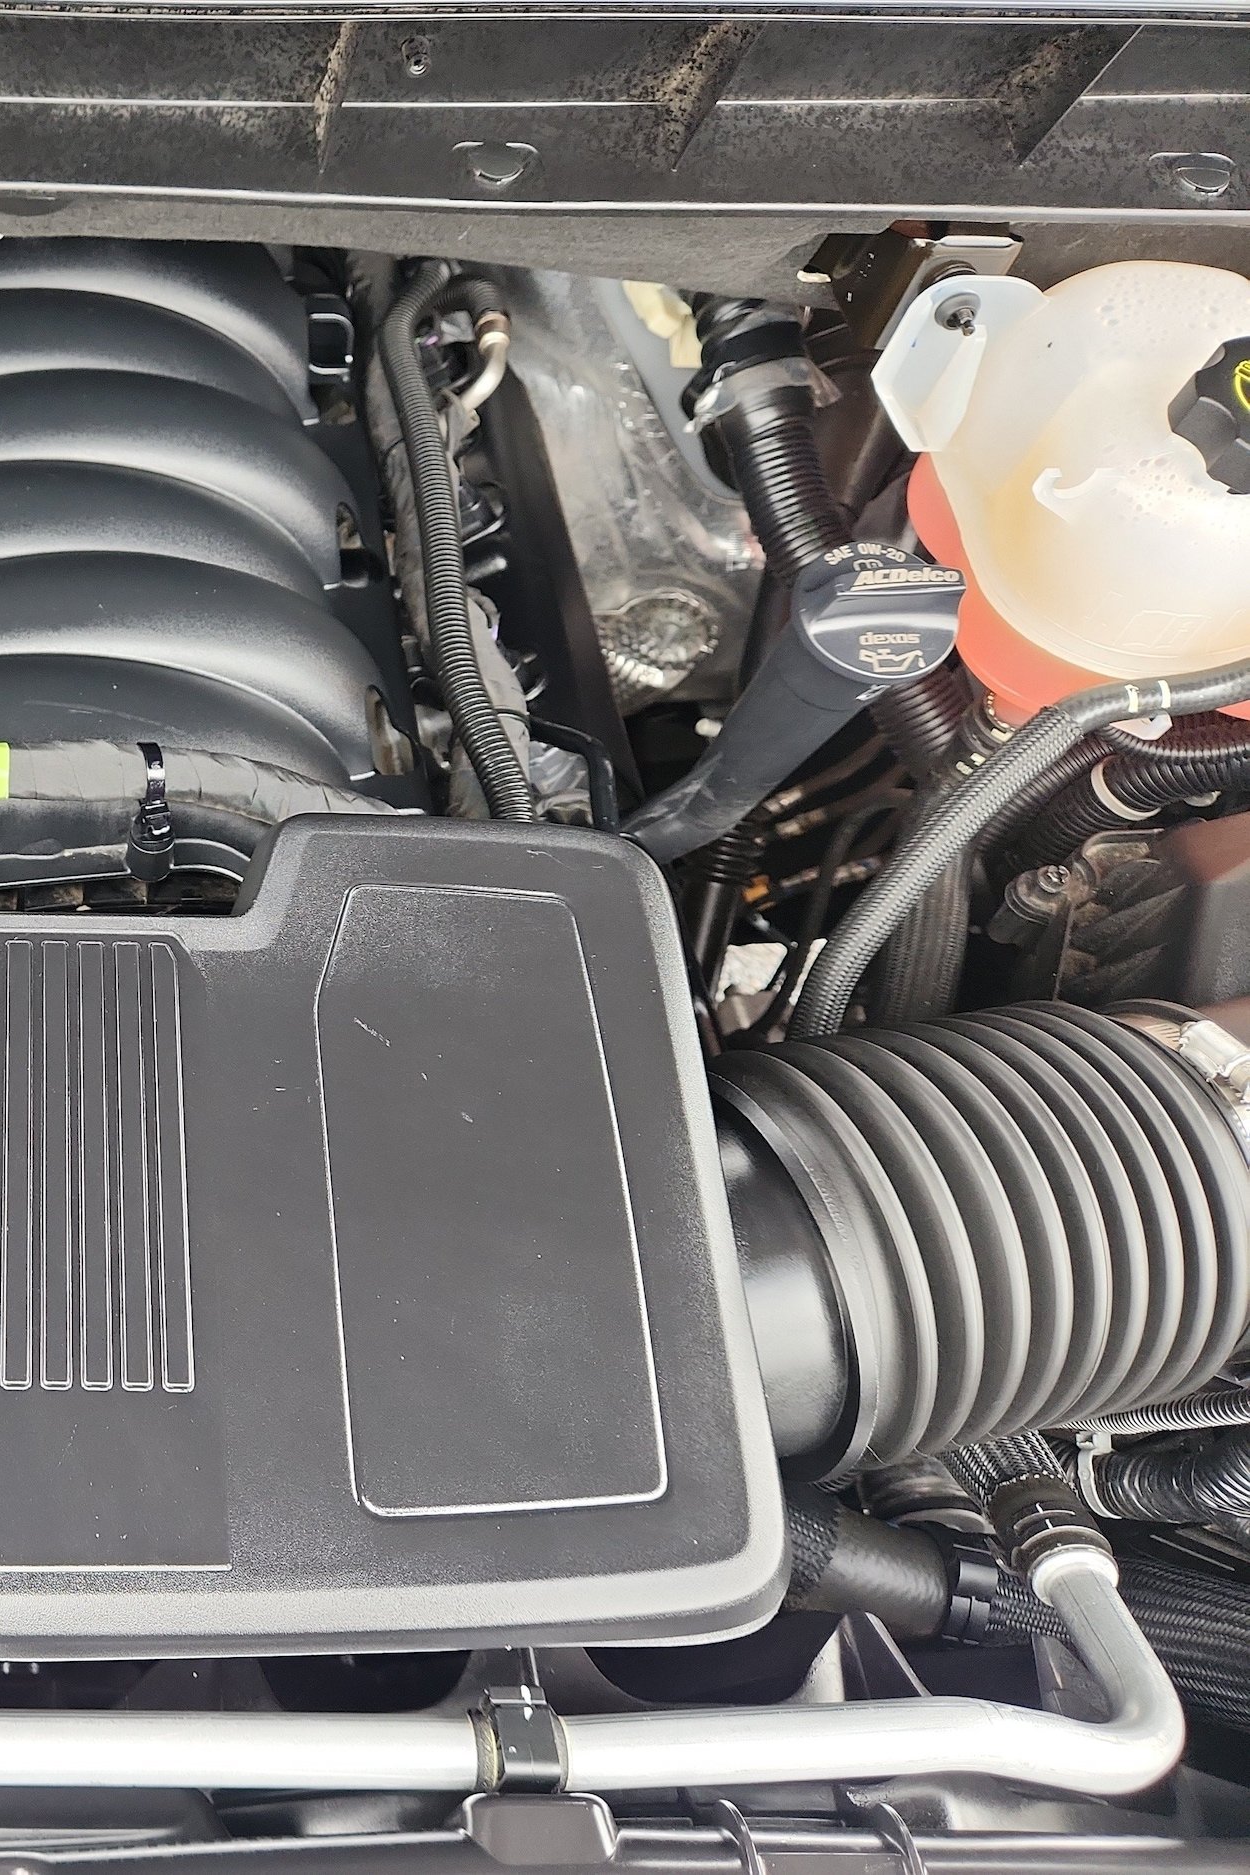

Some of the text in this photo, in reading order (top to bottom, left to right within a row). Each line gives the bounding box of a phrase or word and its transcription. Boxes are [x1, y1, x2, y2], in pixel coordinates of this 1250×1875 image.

[824, 543, 907, 566] SAE 0W-20
[853, 567, 960, 586] ACDelco
[859, 632, 921, 646] dexos
